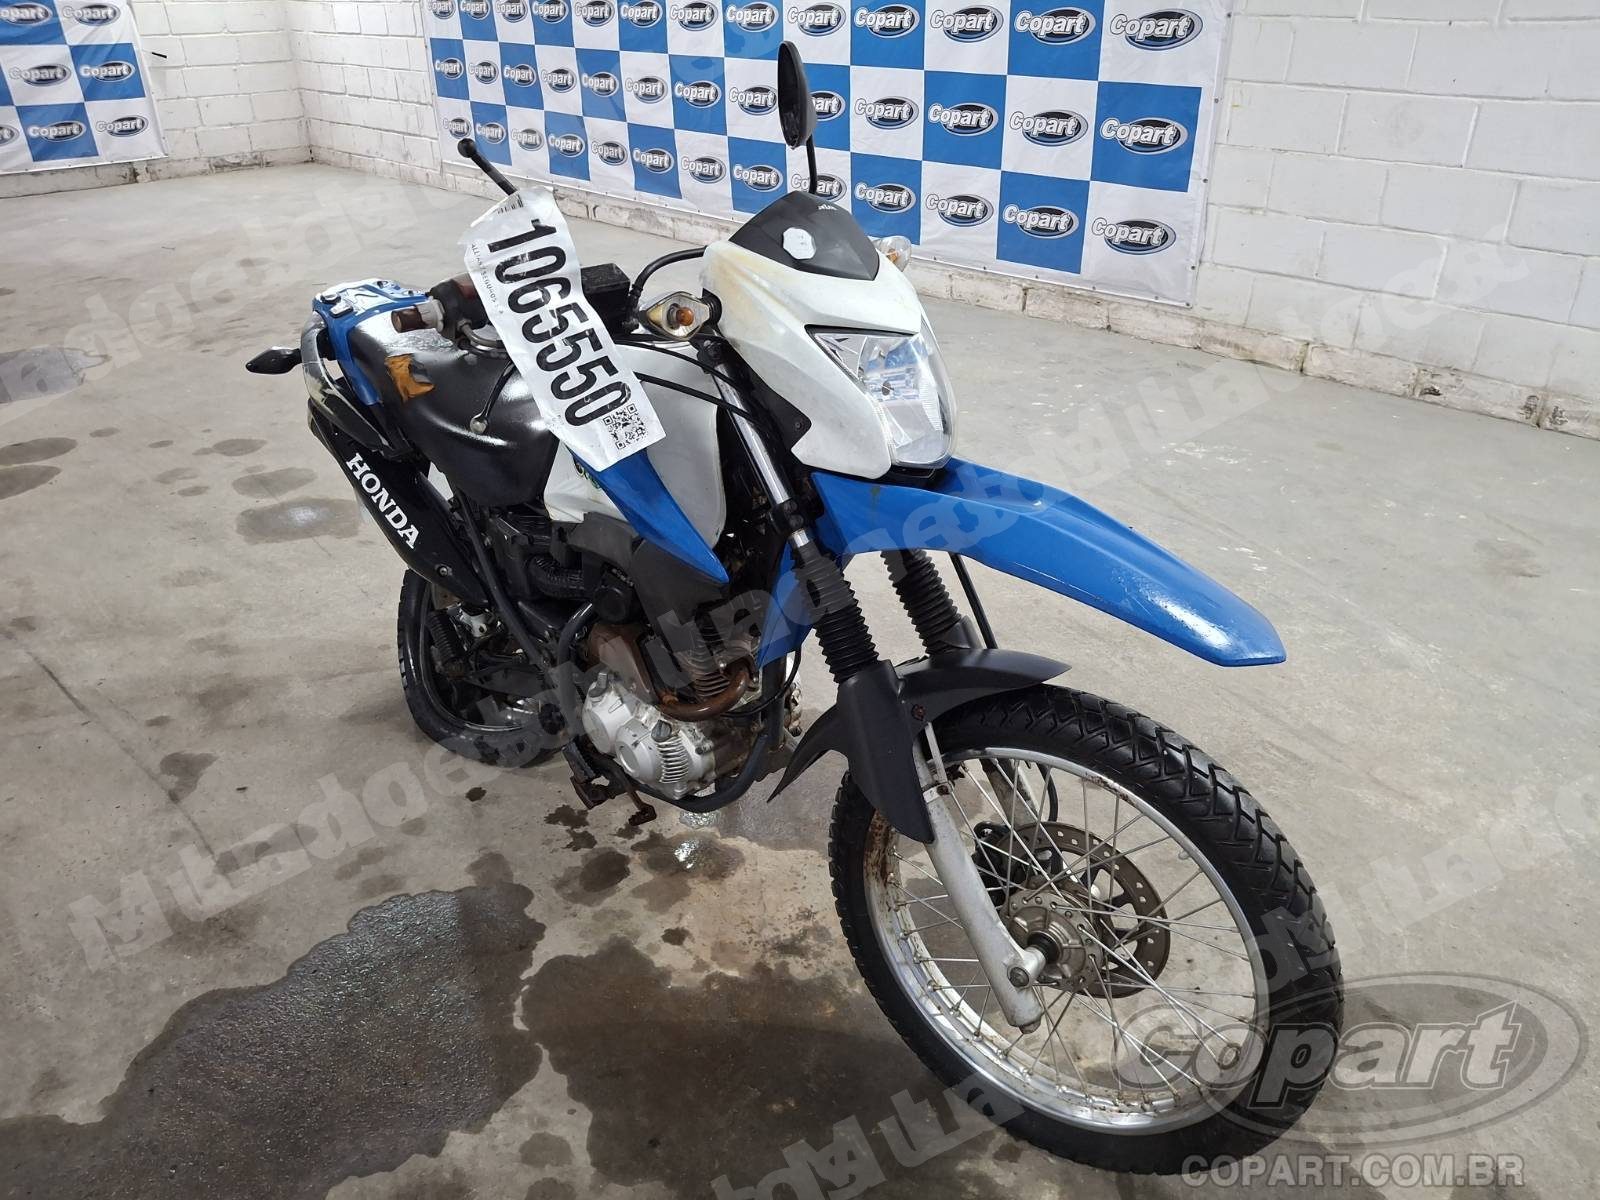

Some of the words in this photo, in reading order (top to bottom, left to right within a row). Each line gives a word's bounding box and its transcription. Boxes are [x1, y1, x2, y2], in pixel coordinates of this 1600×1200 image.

[0, 7, 44, 21] opart
[63, 6, 112, 21] Copart
[428, 0, 451, 12] Copart
[460, 0, 486, 13] Copart
[496, 0, 522, 15] Copart
[532, 2, 564, 17] Copart
[575, 3, 609, 19] Copart
[620, 4, 657, 21] Copart
[670, 6, 711, 24] Copart
[727, 6, 771, 26] Copart
[787, 7, 838, 27] Copart
[854, 8, 911, 31] Copart
[930, 10, 994, 34] Copart
[1015, 10, 1085, 37] Copart
[1110, 14, 1192, 41] Copart
[10, 67, 62, 83] Copart
[80, 65, 127, 80] Copart
[435, 60, 460, 75] Copart
[469, 63, 494, 78] Copart
[504, 66, 532, 82] Copart
[541, 70, 572, 87] Copart
[582, 74, 615, 90] Copart
[625, 79, 662, 96] Copart
[675, 81, 715, 101] Copart
[730, 87, 777, 107] Copart
[855, 98, 911, 122] Copart
[928, 104, 990, 128] Copart
[1010, 111, 1080, 136] Copart
[1100, 118, 1176, 146] Copart
[29, 123, 80, 140] Copart
[96, 118, 142, 134] Copart
[443, 119, 468, 133] Copart
[475, 123, 501, 138] Copart
[512, 130, 539, 145] Copart
[549, 135, 580, 151] Copart
[592, 143, 623, 160] Copart
[633, 149, 670, 167] Copart
[681, 157, 720, 176] Copart
[734, 165, 777, 185] Copart
[791, 174, 839, 195] Coart
[855, 183, 911, 206] Copart
[926, 194, 986, 219] Copart
[1003, 205, 1072, 231] Copart
[1092, 218, 1164, 246] Copart
[488, 219, 631, 426] 1065550
[346, 452, 419, 549] HONDA
